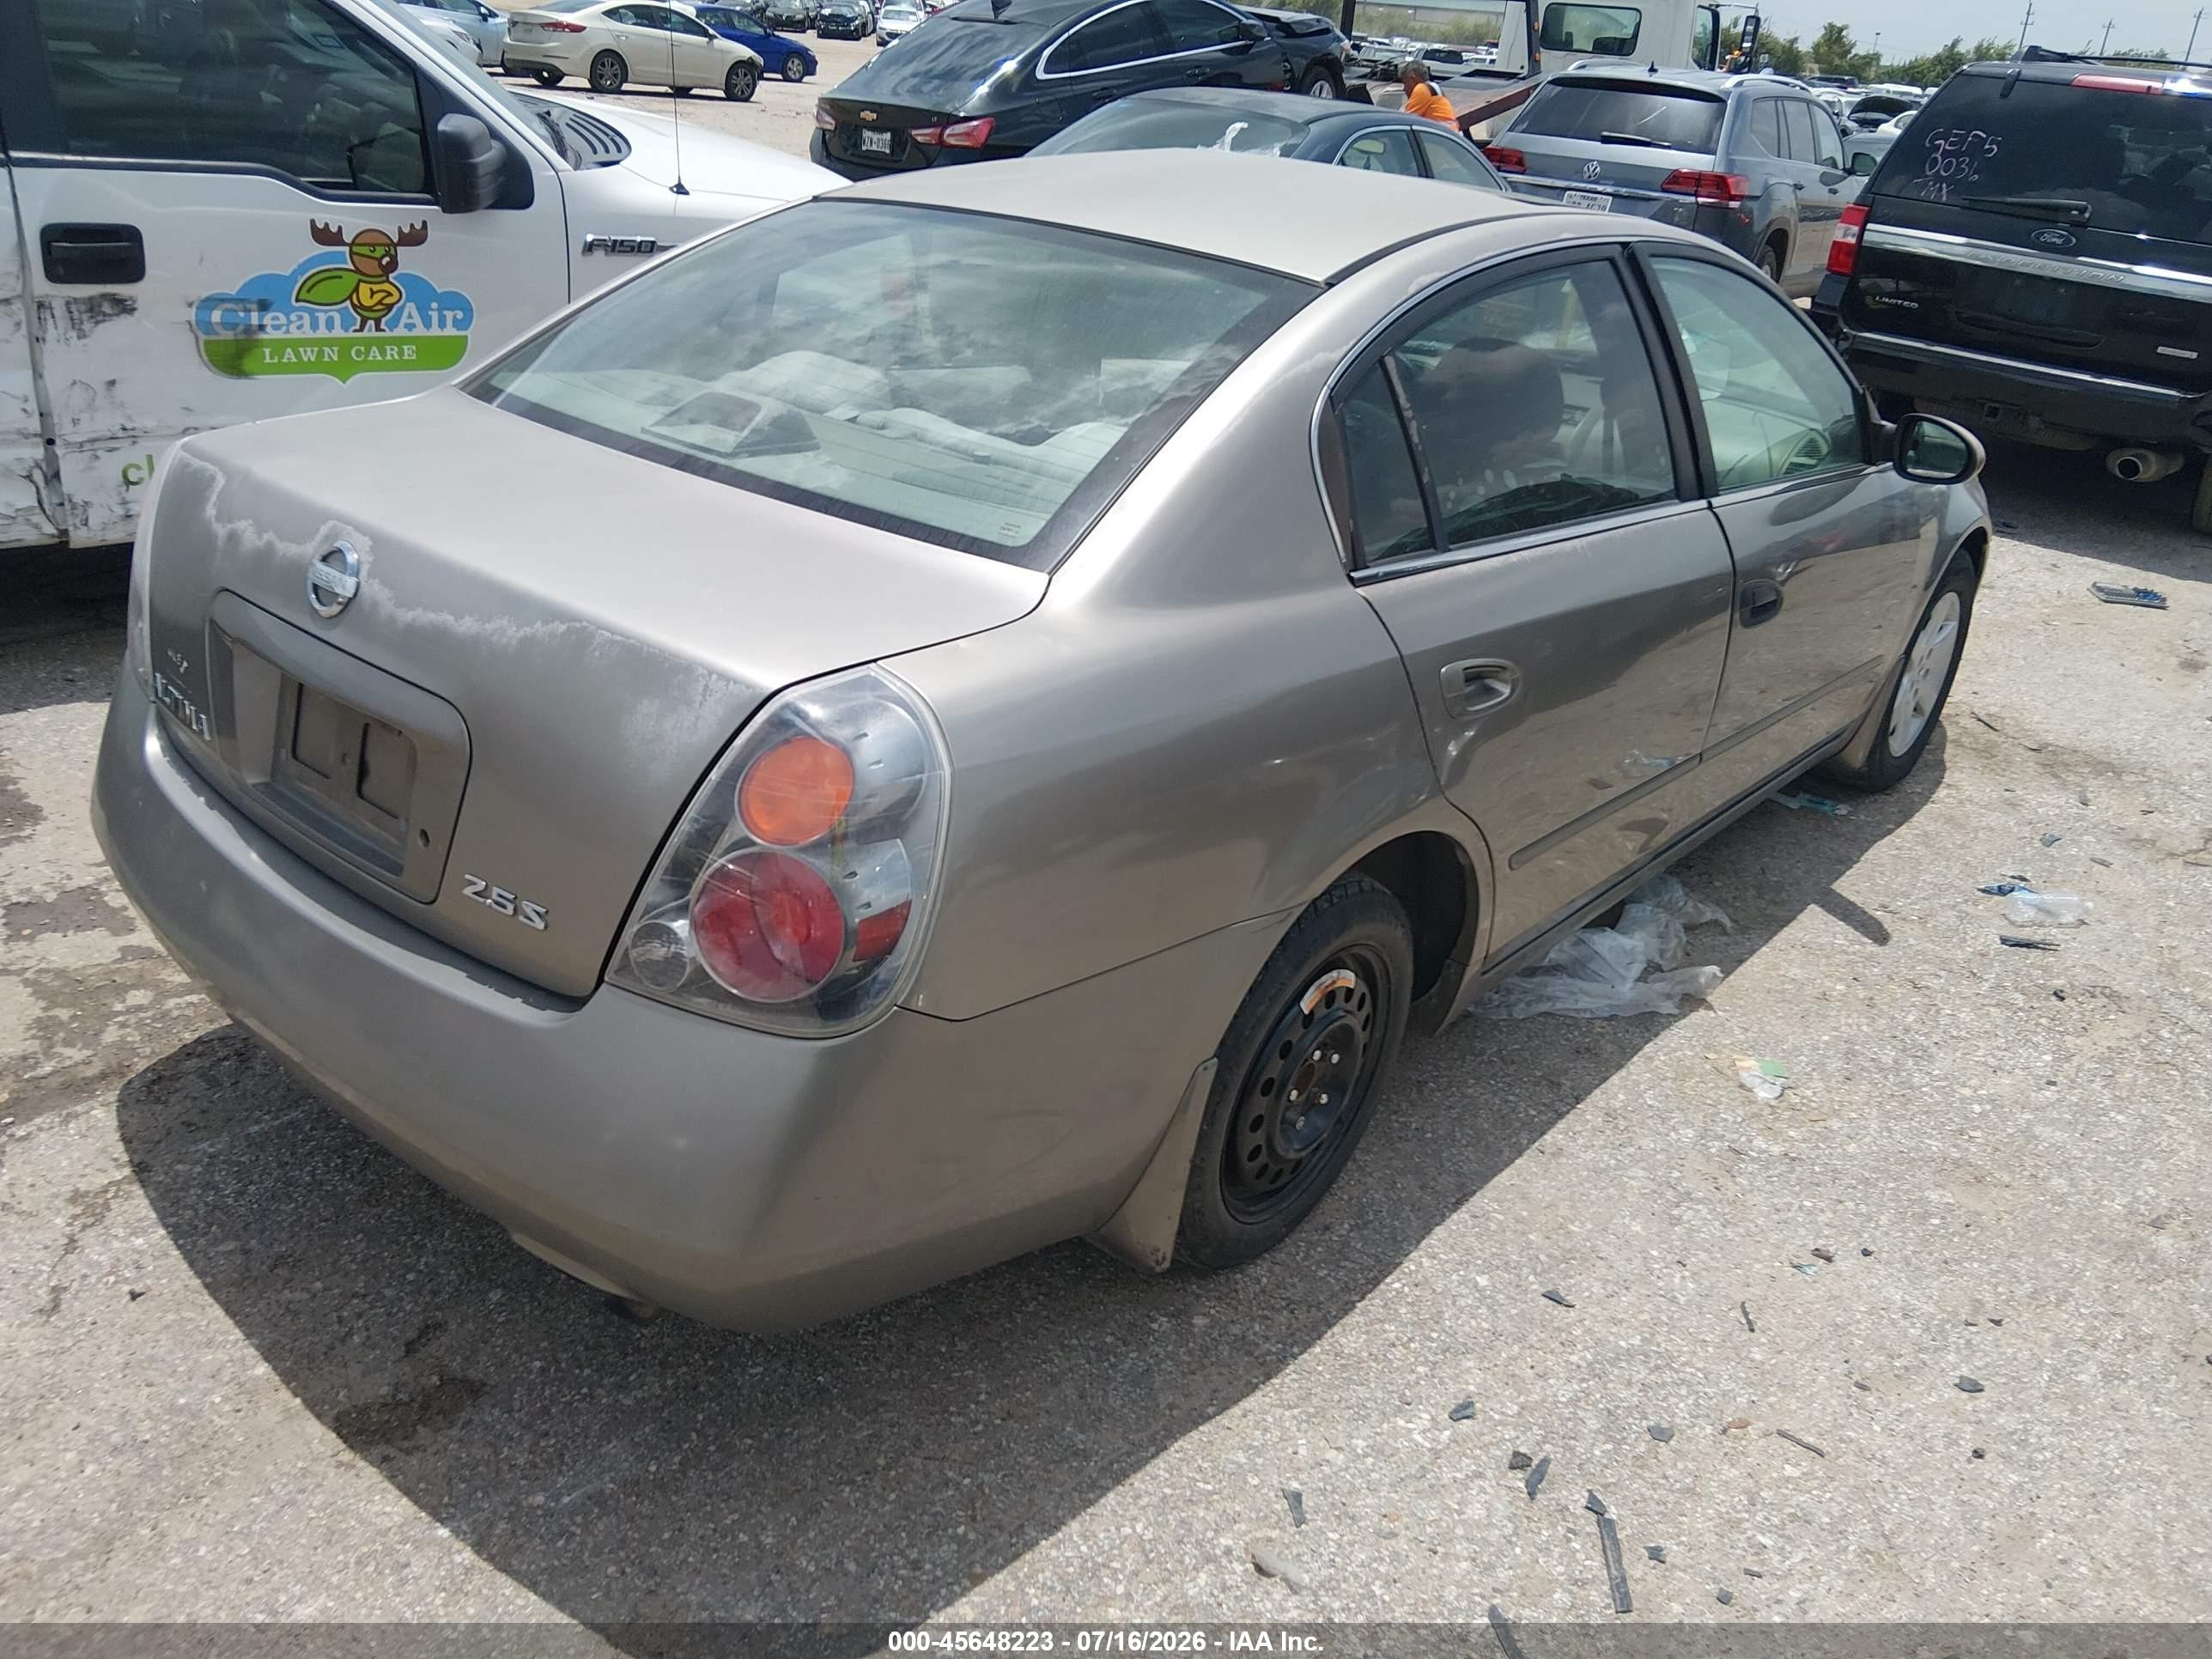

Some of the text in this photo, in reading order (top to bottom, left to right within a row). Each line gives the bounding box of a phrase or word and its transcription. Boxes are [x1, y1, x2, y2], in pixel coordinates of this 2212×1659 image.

[1875, 295, 1919, 309] LIMITED
[211, 301, 465, 336] Clean Air
[262, 344, 417, 363] LAWN CARE
